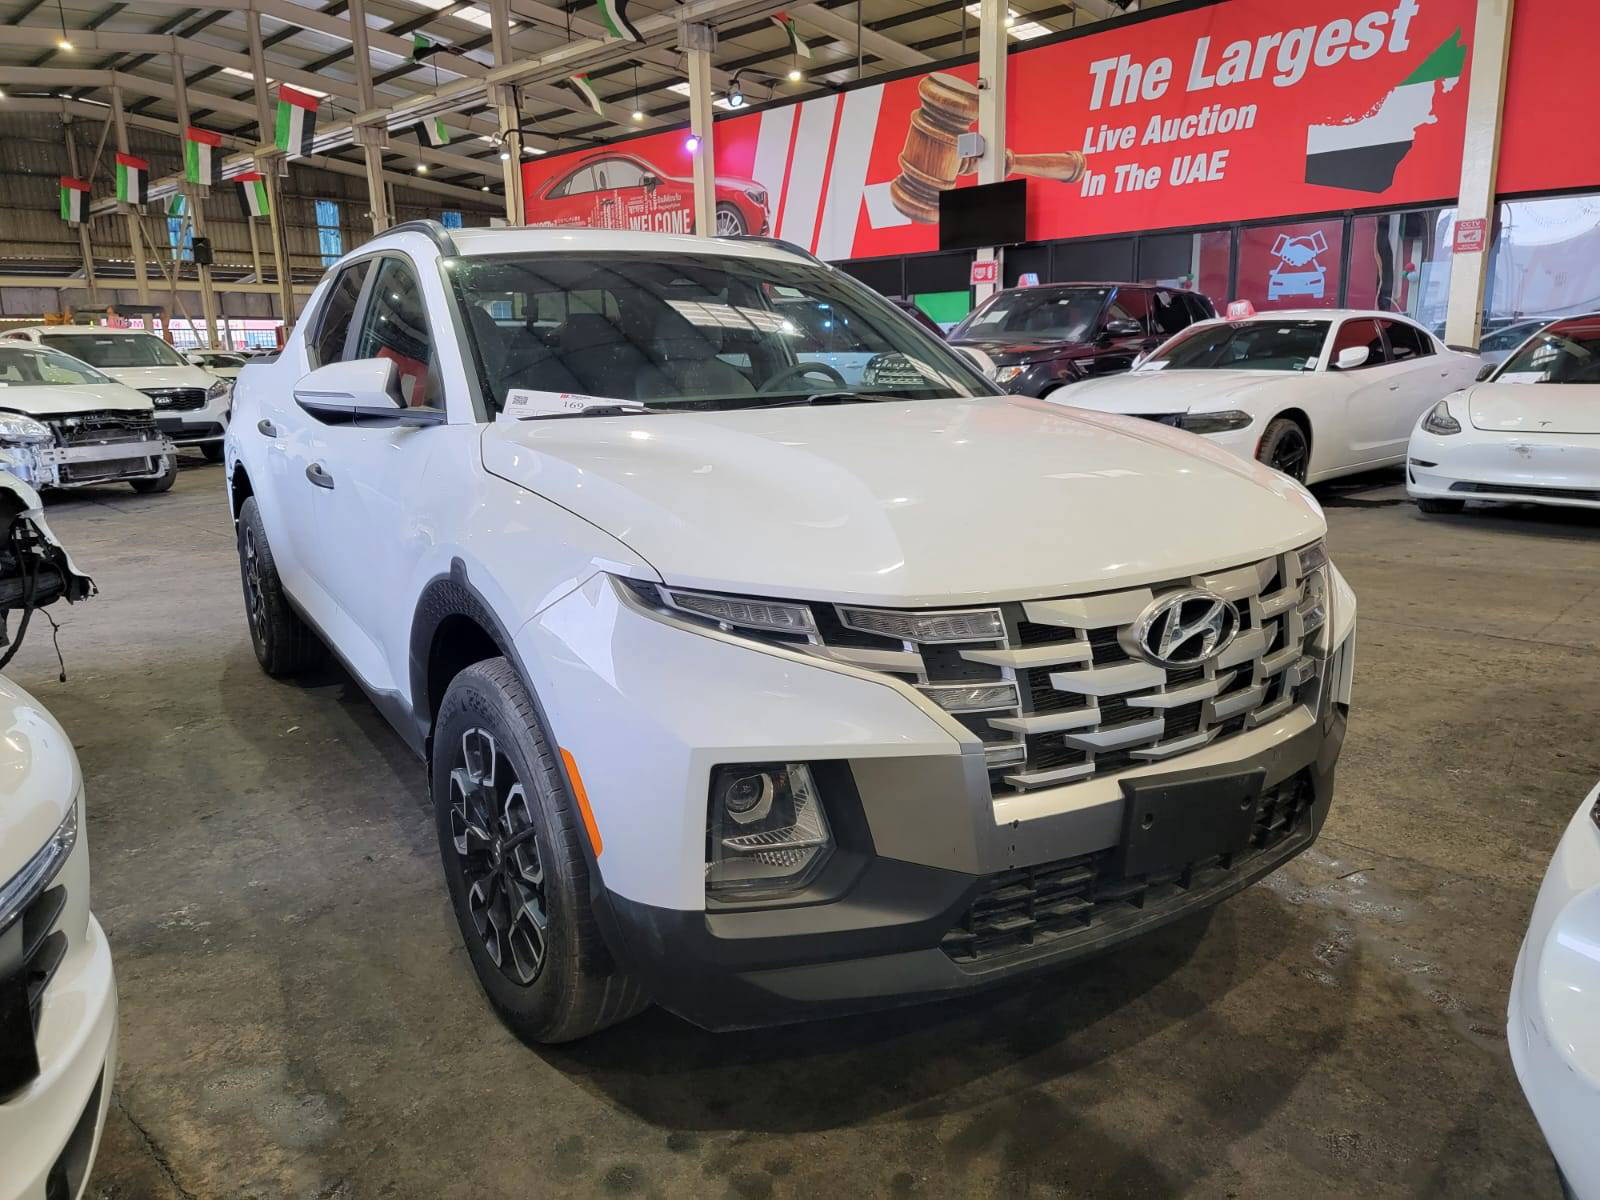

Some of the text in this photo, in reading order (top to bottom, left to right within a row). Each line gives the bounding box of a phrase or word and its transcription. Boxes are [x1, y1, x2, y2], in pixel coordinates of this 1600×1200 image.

[1090, 0, 1419, 110] The Largest
[1083, 103, 1258, 156] Live Auction
[1080, 150, 1229, 198] In The UAE
[629, 208, 691, 234] WELCOME
